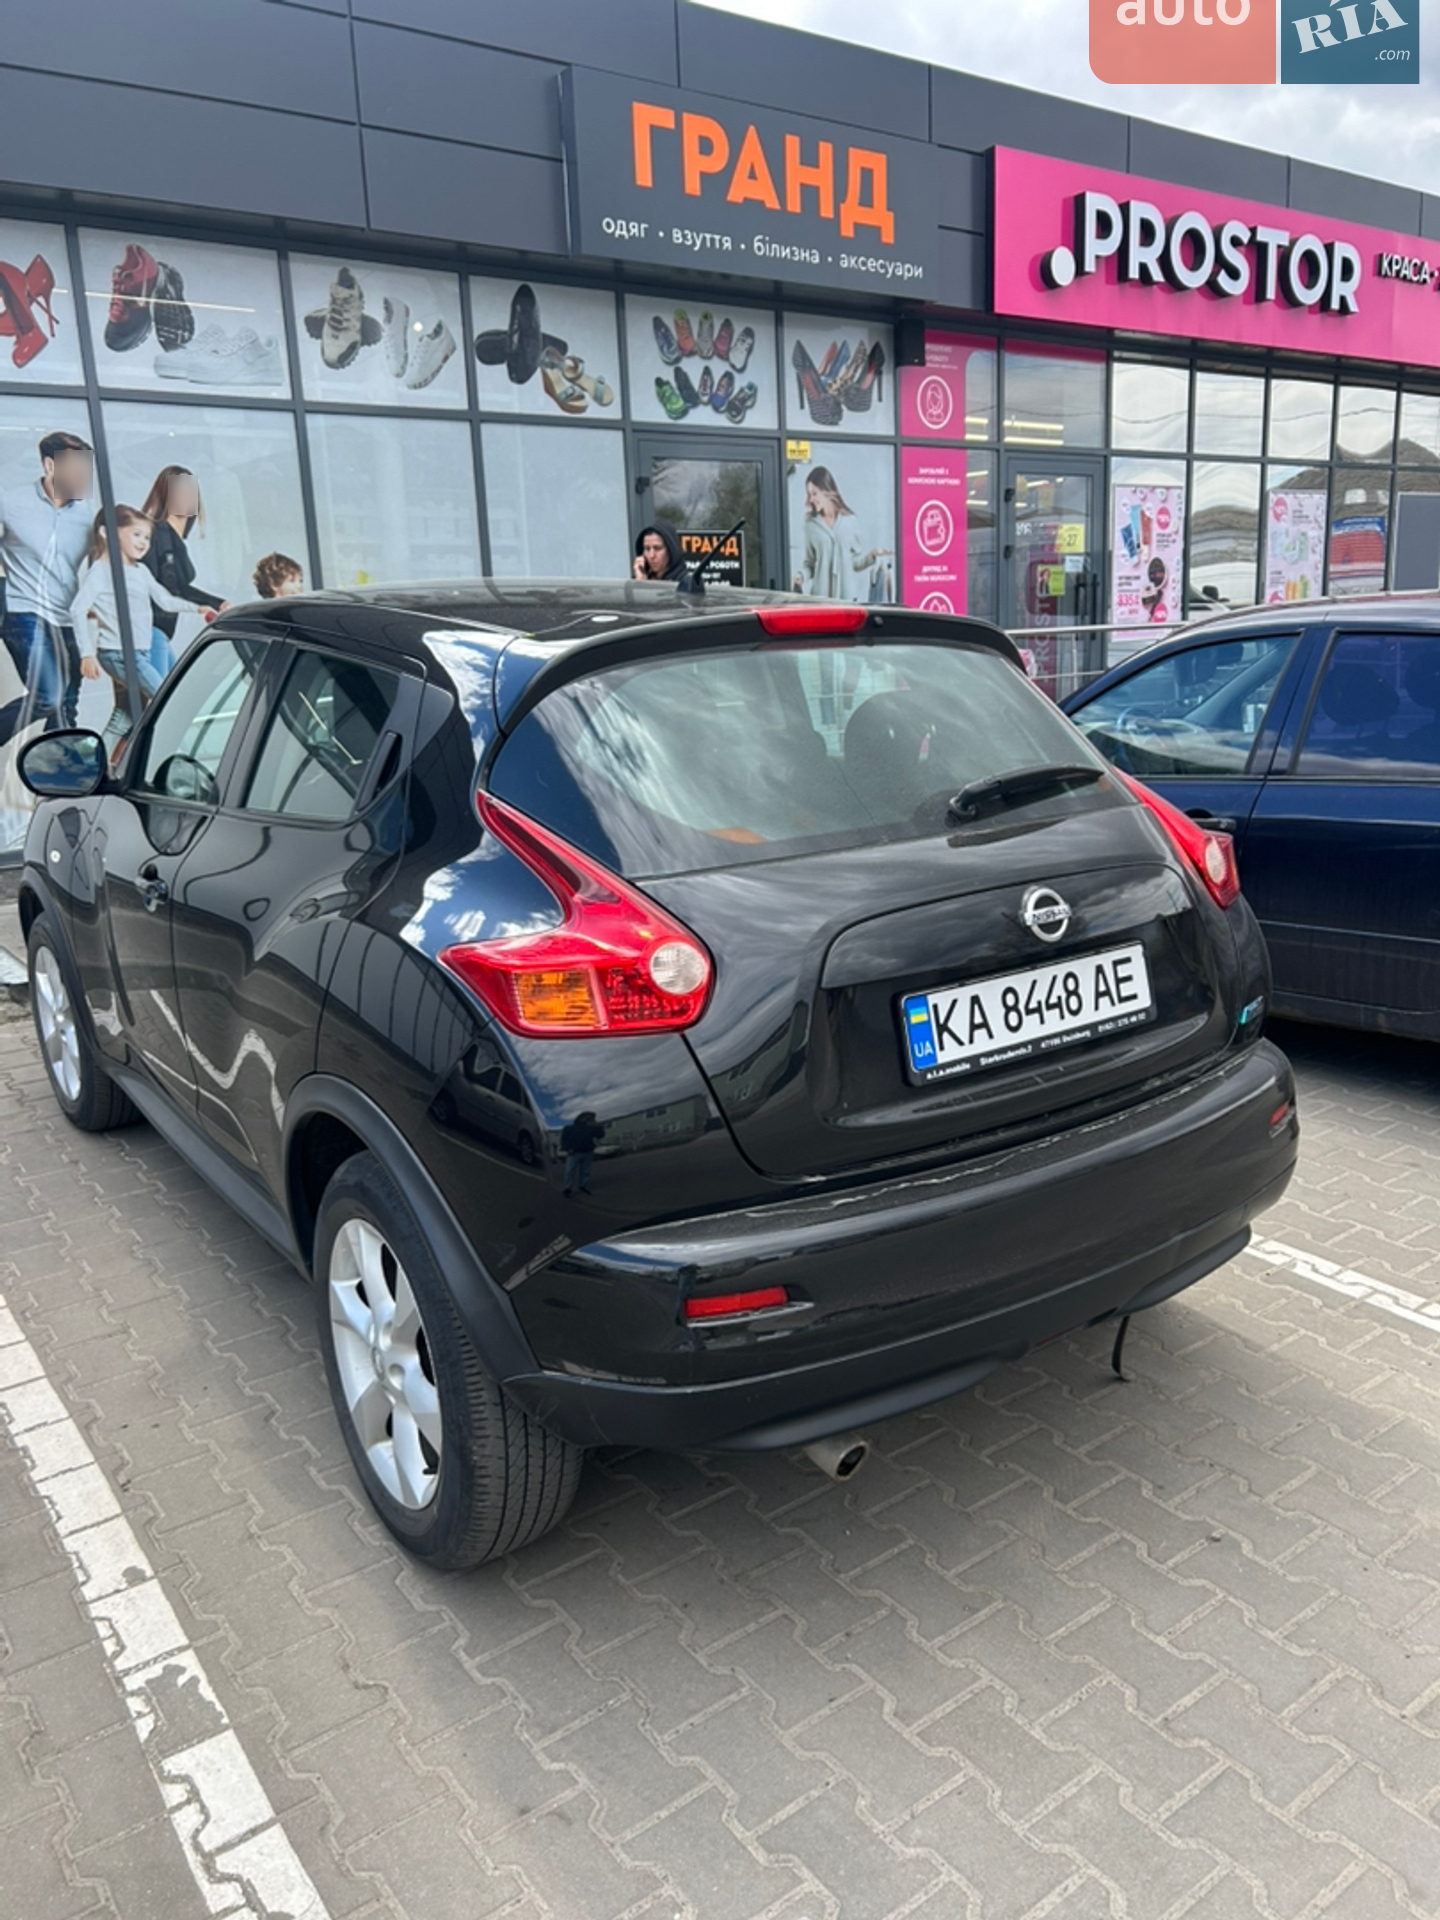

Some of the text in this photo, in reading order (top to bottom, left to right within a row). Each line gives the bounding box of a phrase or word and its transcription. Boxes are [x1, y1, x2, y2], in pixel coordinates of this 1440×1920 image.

[631, 101, 895, 245] ГРАНД
[601, 216, 924, 281] одяг взуття білизна аксесуари
[1380, 252, 1430, 284] КРАСА
[931, 956, 1139, 1052] KA 8448 AE
[913, 1040, 934, 1058] UA
